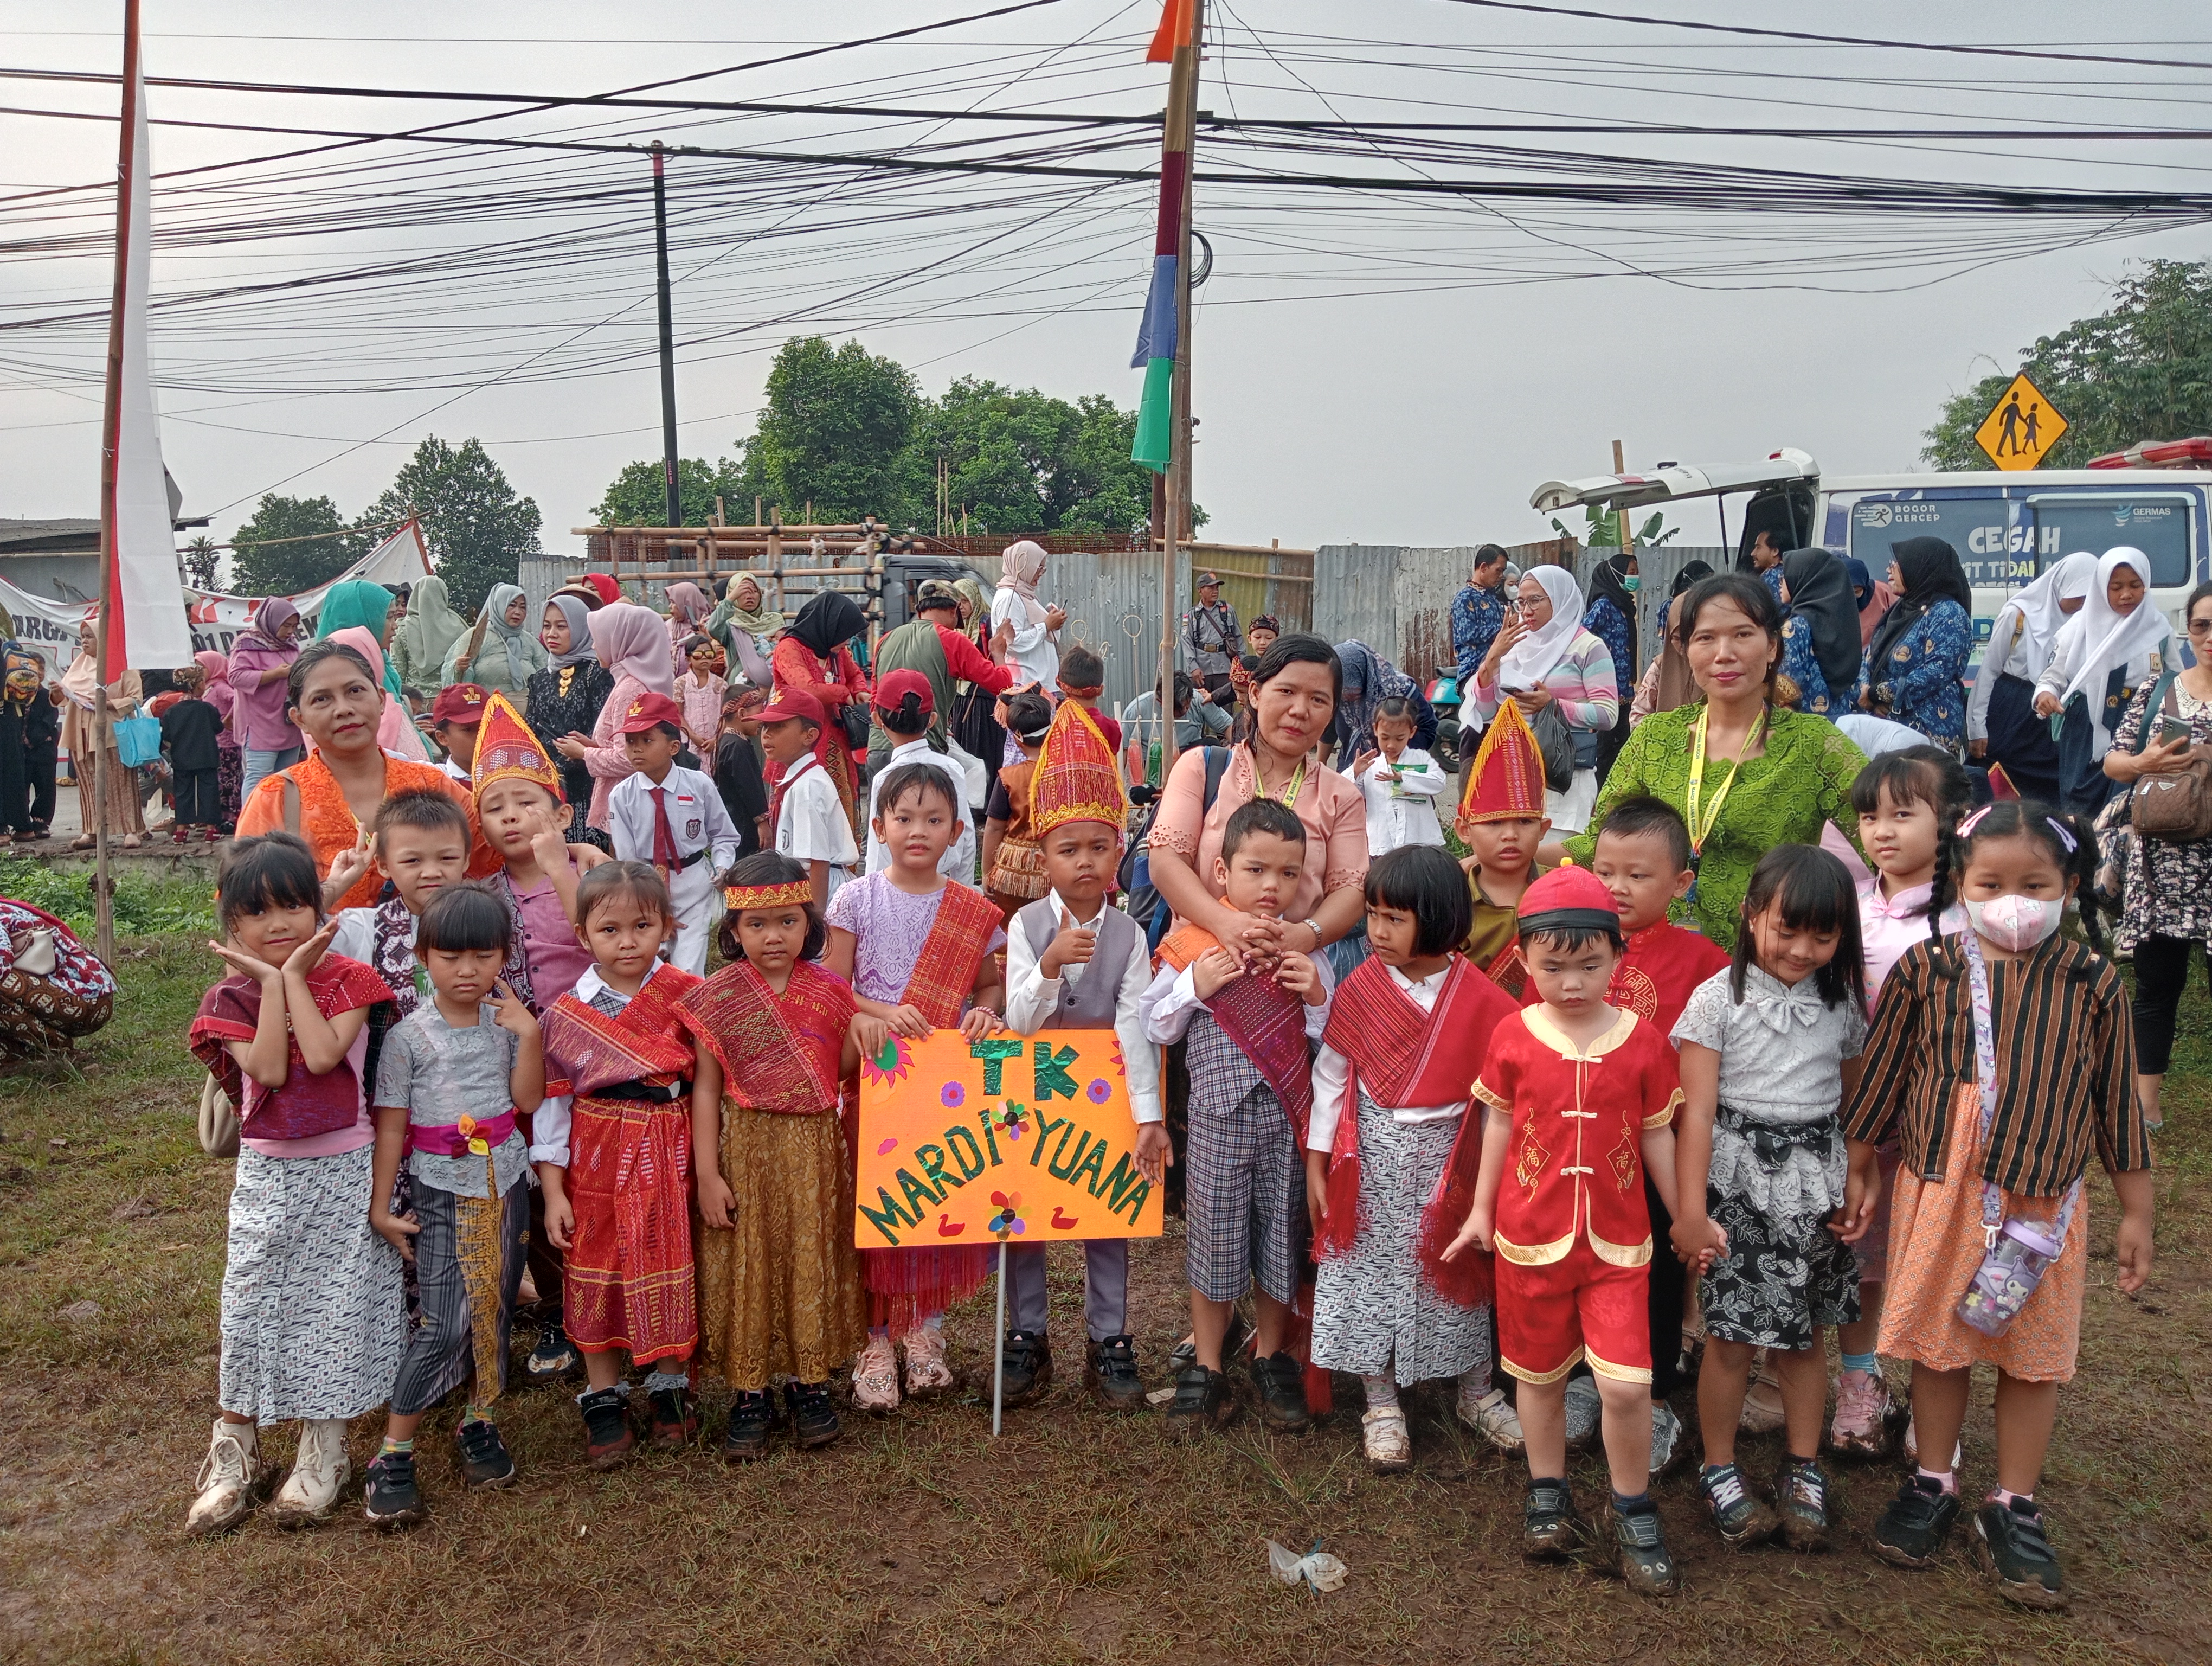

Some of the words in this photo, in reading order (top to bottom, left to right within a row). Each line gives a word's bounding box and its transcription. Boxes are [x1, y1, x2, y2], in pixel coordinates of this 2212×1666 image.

[1895, 505, 1936, 513] BOGOR
[1895, 514, 1941, 522] GERCEP
[1968, 526, 2061, 554] CEGAH
[970, 1039, 1081, 1101] TK
[858, 1108, 1004, 1247] MARDI
[1030, 1107, 1152, 1227] YUANA
[1707, 1466, 1735, 1484] Skechers
